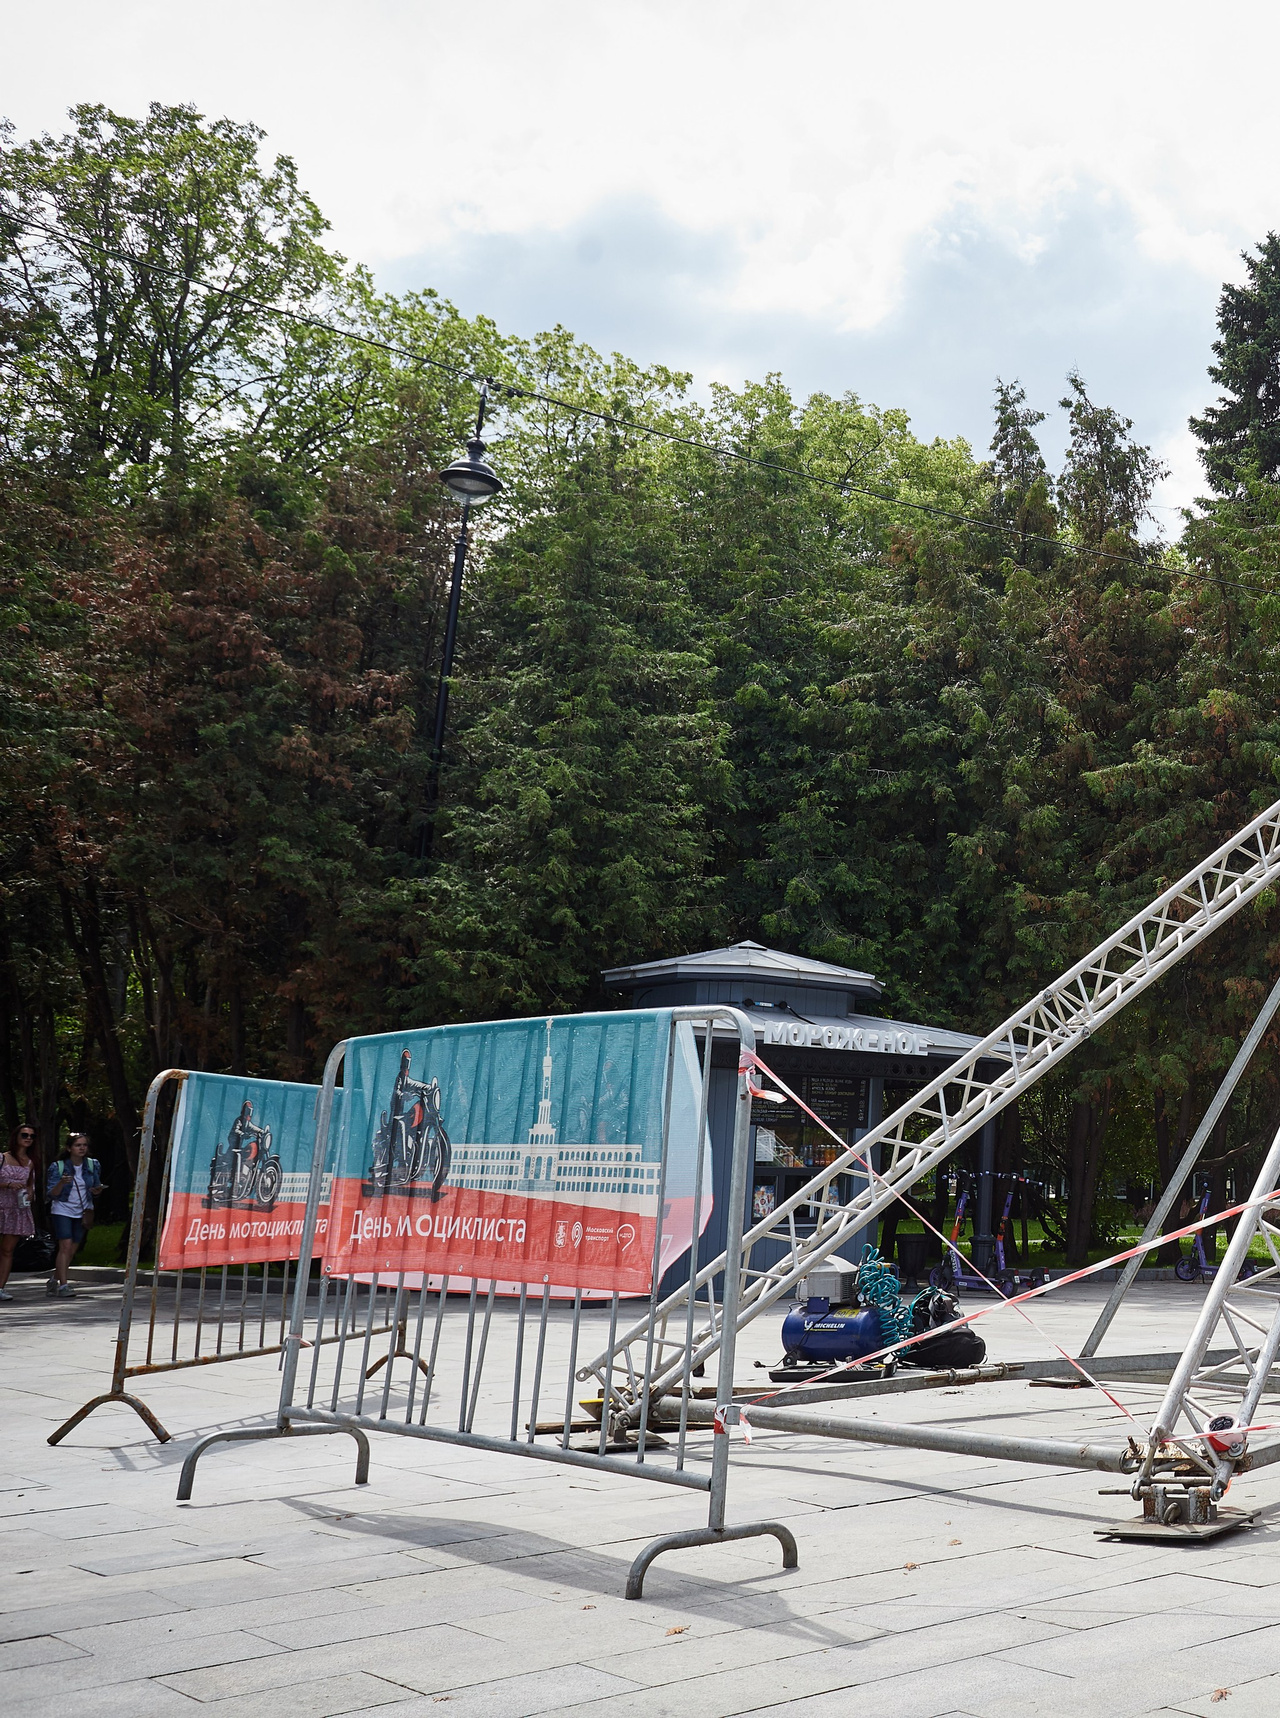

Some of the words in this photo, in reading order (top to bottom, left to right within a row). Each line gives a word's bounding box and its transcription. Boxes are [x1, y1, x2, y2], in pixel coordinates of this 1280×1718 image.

[763, 1020, 930, 1056] МОРОЖЕНОЕ
[184, 1218, 226, 1246] День
[229, 1218, 329, 1239] мотоциклта
[350, 1210, 392, 1244] День
[585, 1226, 614, 1234] Московский
